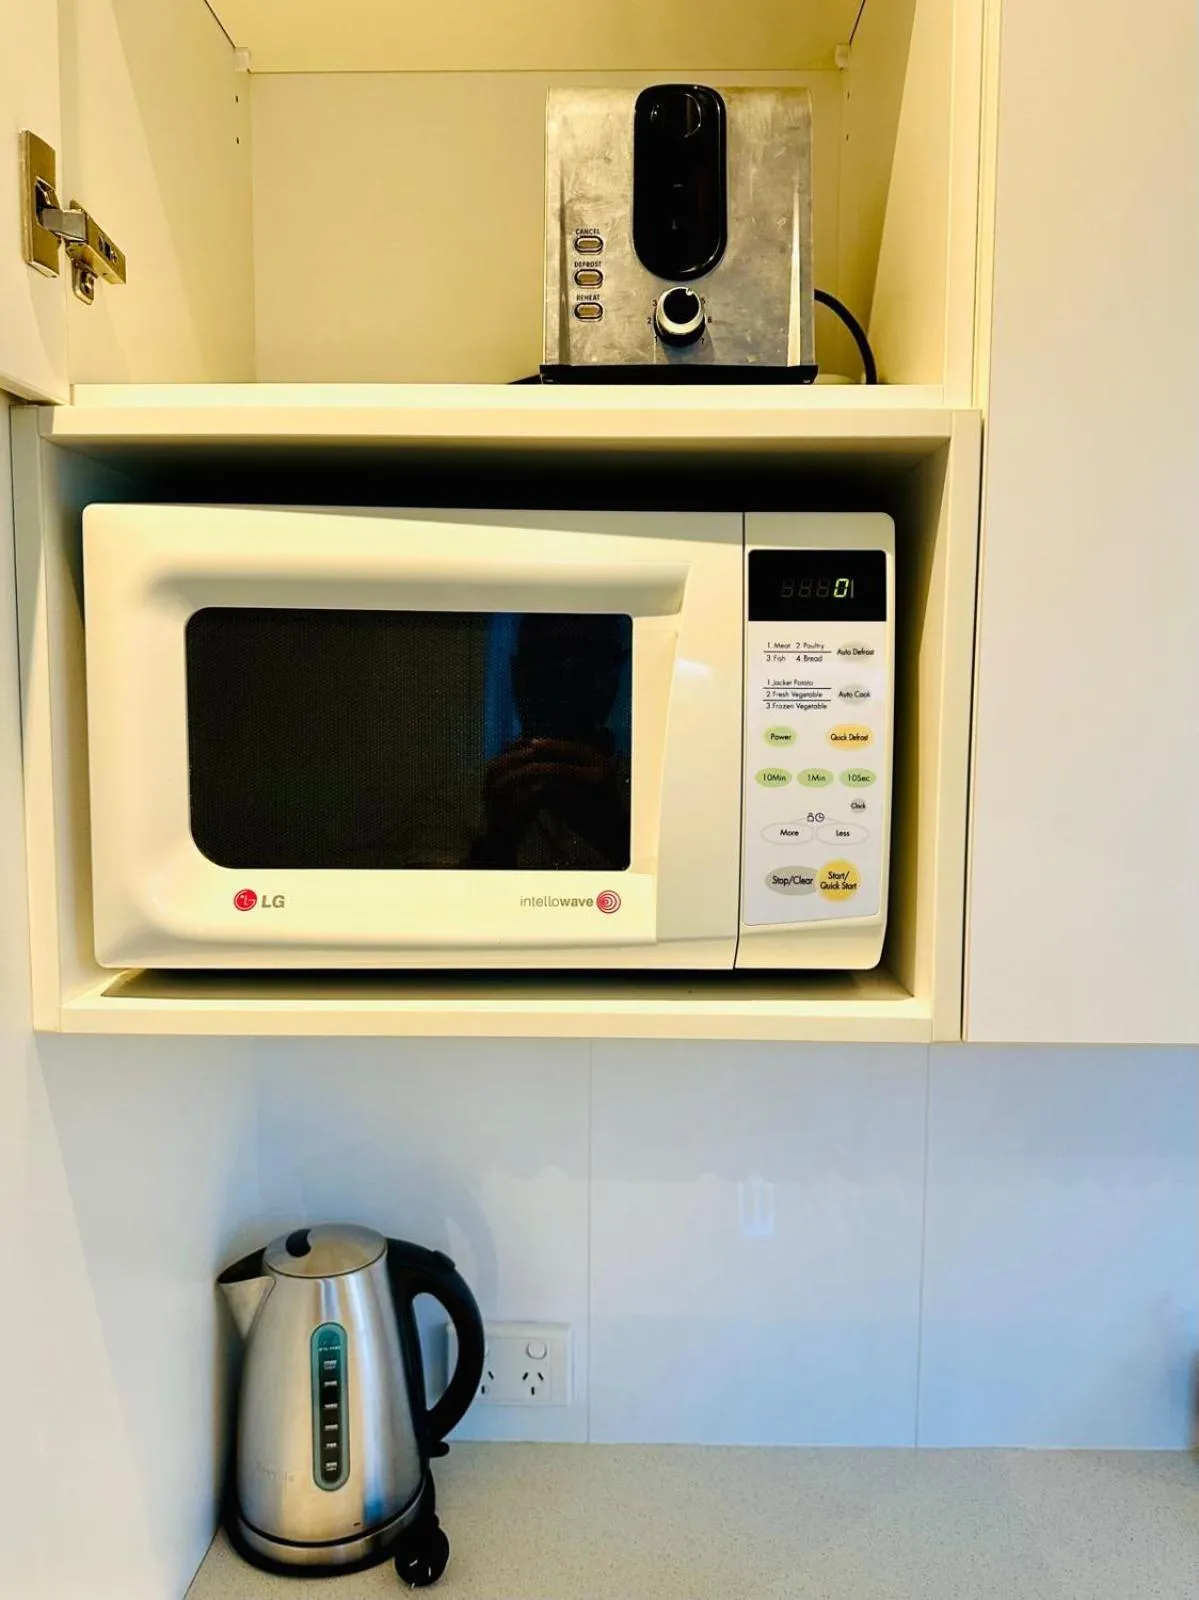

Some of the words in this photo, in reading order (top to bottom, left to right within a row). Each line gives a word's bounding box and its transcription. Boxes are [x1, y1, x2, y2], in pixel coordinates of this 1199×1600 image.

[803, 641, 825, 650] Poultry
[836, 648, 851, 656] Auto
[852, 648, 875, 656] Defrost
[803, 654, 823, 662] Bread
[772, 690, 790, 698] Fresh
[791, 690, 823, 699] Vegetable
[838, 690, 853, 698] Auto
[854, 690, 871, 698] Cook
[796, 702, 828, 711] Vegetable
[770, 732, 792, 741] Power
[830, 732, 848, 742] Quick
[849, 732, 869, 741] Defrost
[763, 773, 787, 782] 10Min
[848, 773, 871, 782] 10Sec
[850, 801, 866, 810] Clock
[780, 828, 800, 837] More
[836, 829, 850, 838] Less
[771, 874, 814, 886] Stop/Clear
[828, 871, 850, 882] Start/
[820, 881, 840, 891] Quick
[841, 881, 858, 891] Start
[261, 894, 286, 909] LG
[519, 895, 594, 908] intellowave
